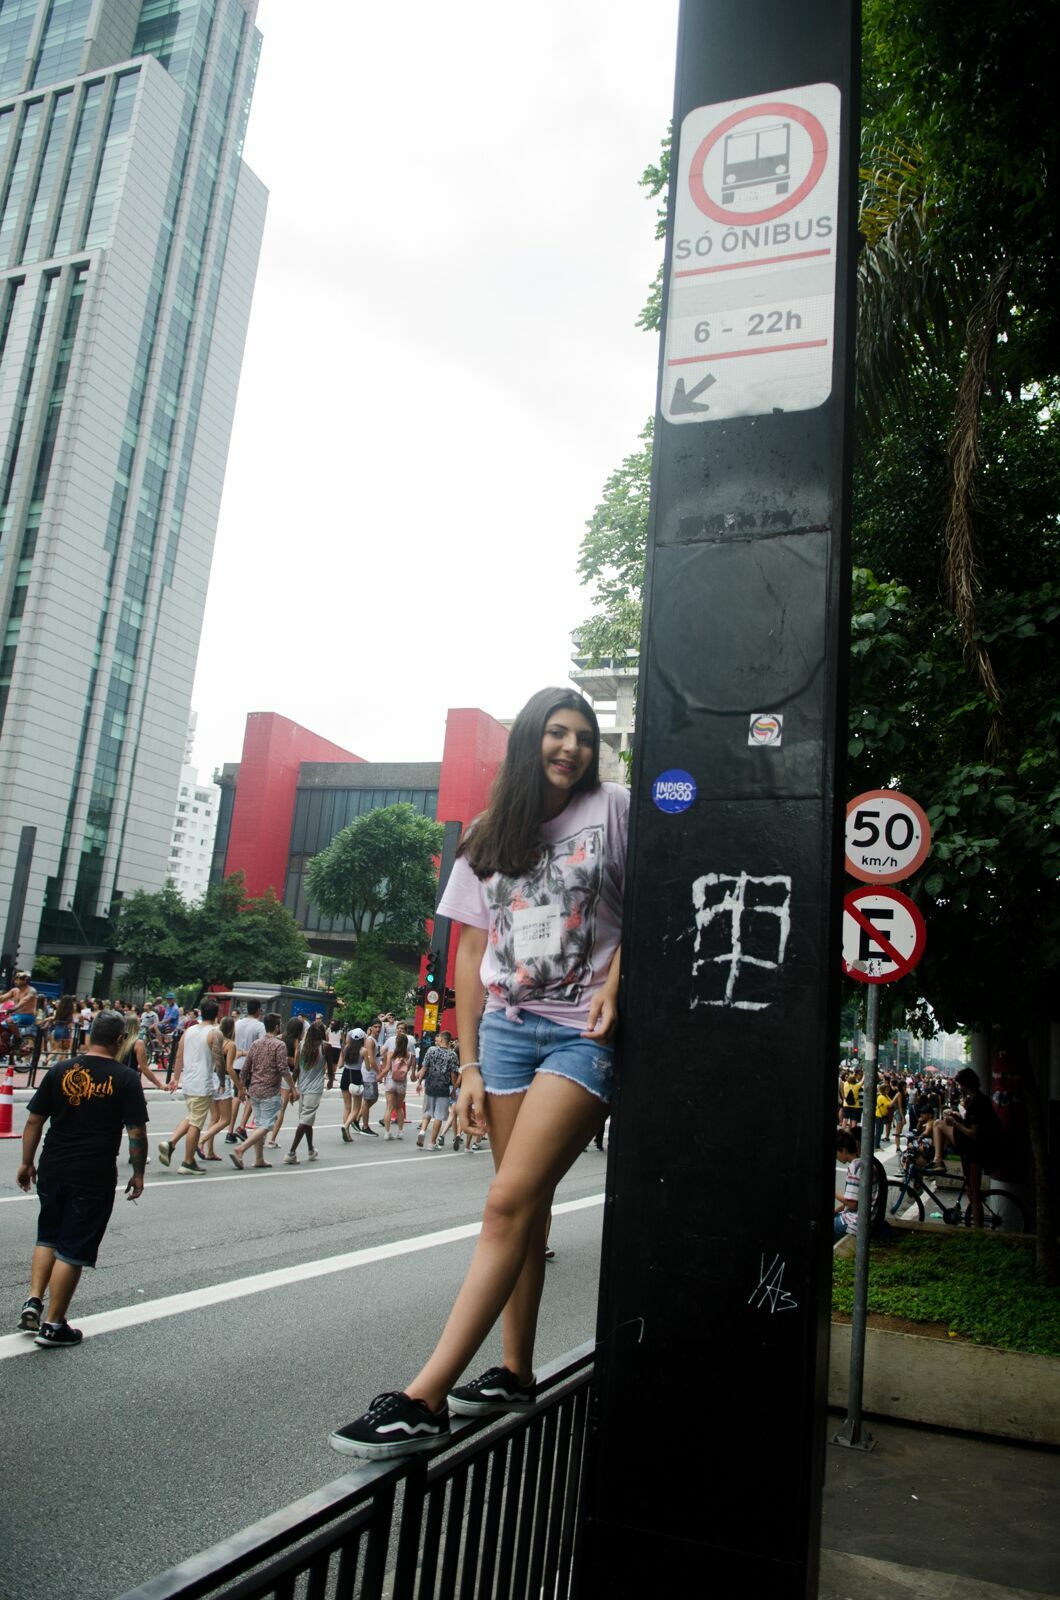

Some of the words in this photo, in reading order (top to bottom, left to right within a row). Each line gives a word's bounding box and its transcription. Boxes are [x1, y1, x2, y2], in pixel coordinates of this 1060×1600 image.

[675, 230, 713, 260] SÓ
[721, 216, 833, 253] ÔNIBUS
[694, 320, 711, 344] 6
[747, 310, 802, 336] 22h
[655, 790, 692, 802] MOOD
[656, 781, 694, 794] INDIGO
[851, 810, 914, 851] 50
[861, 855, 898, 867] km/h
[858, 908, 895, 963] E
